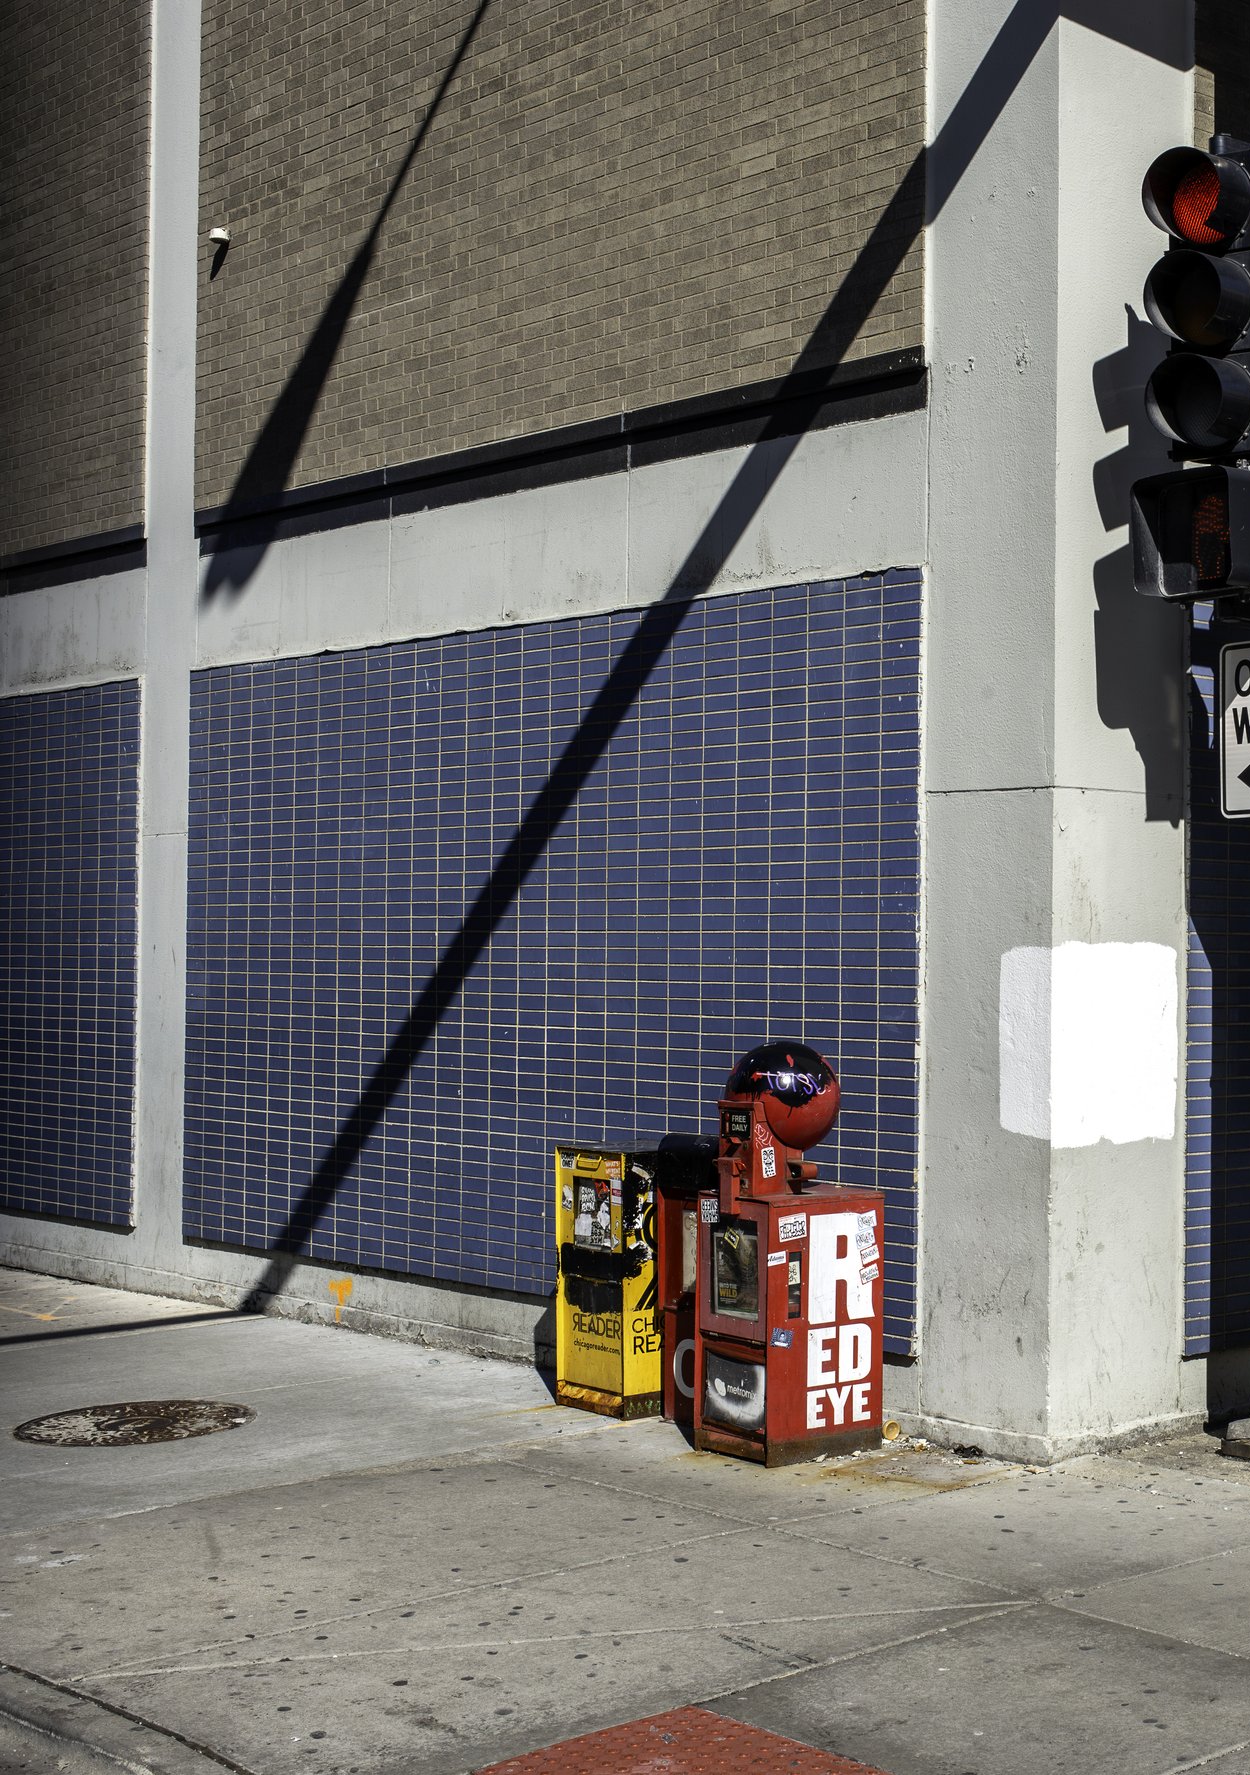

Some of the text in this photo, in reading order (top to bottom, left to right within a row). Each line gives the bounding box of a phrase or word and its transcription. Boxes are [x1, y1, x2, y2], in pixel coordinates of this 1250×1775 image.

[731, 1114, 747, 1123] FREE
[731, 1124, 748, 1132] DAILY
[808, 1212, 875, 1325] R
[719, 1288, 738, 1298] WILD
[573, 1337, 621, 1355] chicagoreader.com
[807, 1323, 872, 1387] ED
[726, 1384, 757, 1400] metromix
[807, 1382, 872, 1429] EYE
